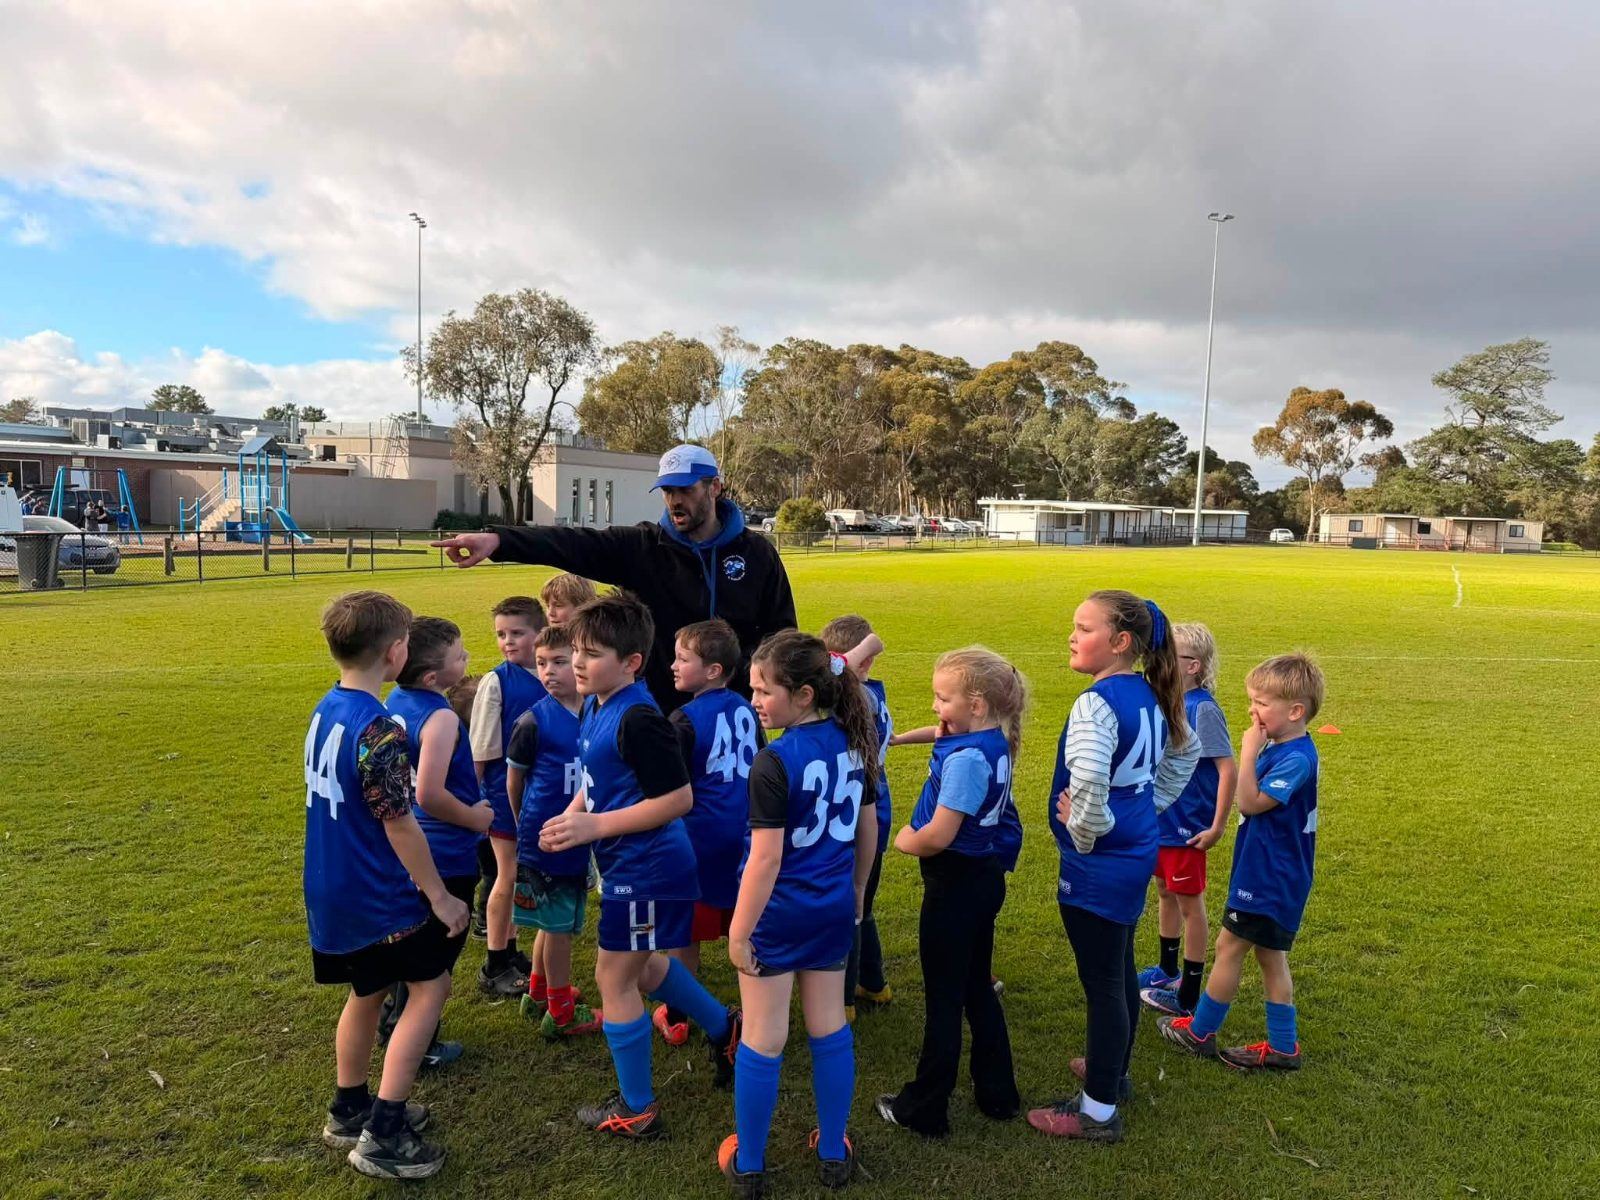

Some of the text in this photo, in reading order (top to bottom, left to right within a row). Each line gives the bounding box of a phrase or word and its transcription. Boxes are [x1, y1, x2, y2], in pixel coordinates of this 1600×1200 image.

[305, 712, 345, 820] 44
[706, 706, 758, 782] 48
[792, 750, 865, 848] 35
